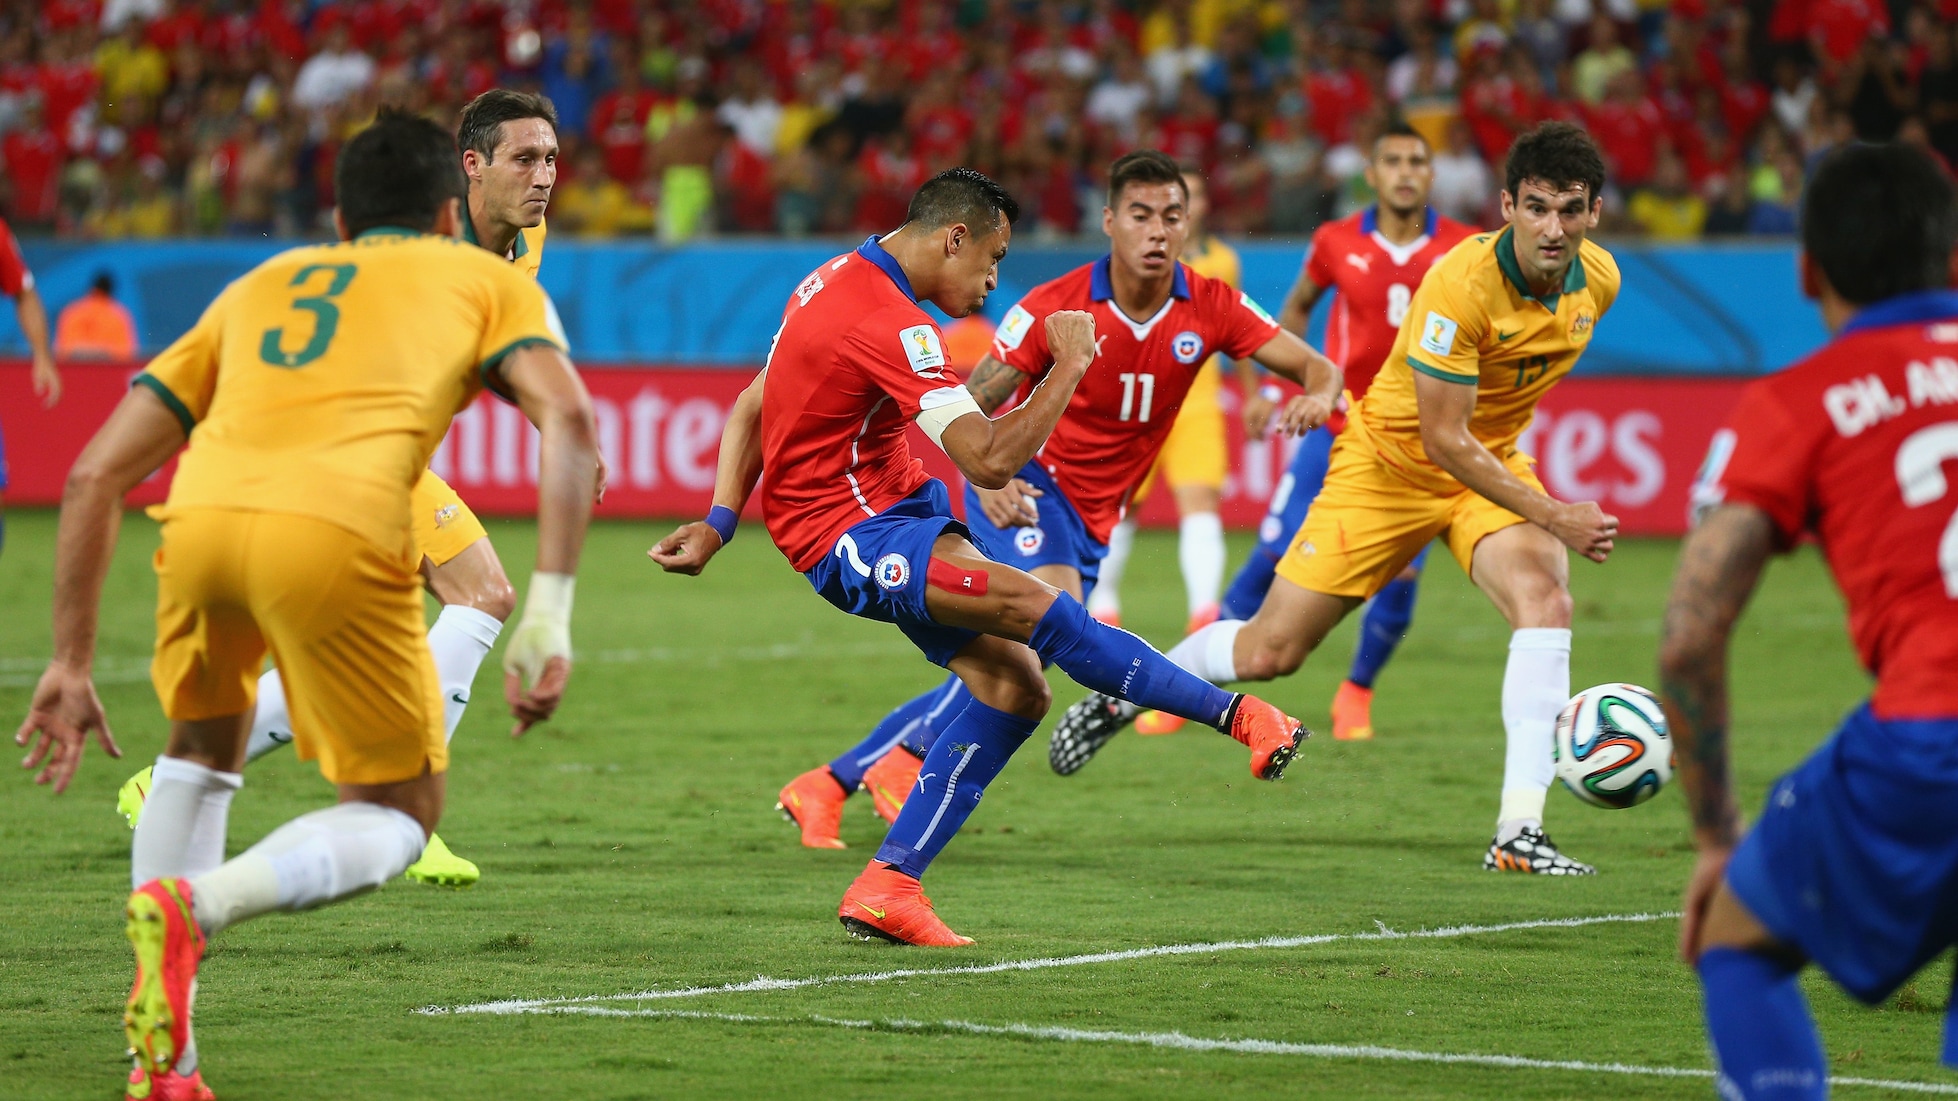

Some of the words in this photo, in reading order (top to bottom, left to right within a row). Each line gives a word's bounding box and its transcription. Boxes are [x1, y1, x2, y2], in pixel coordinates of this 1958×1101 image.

[258, 263, 358, 370] 3
[1387, 283, 1411, 327] 8
[1119, 372, 1155, 423] 11
[1119, 657, 1142, 695] CHILE
